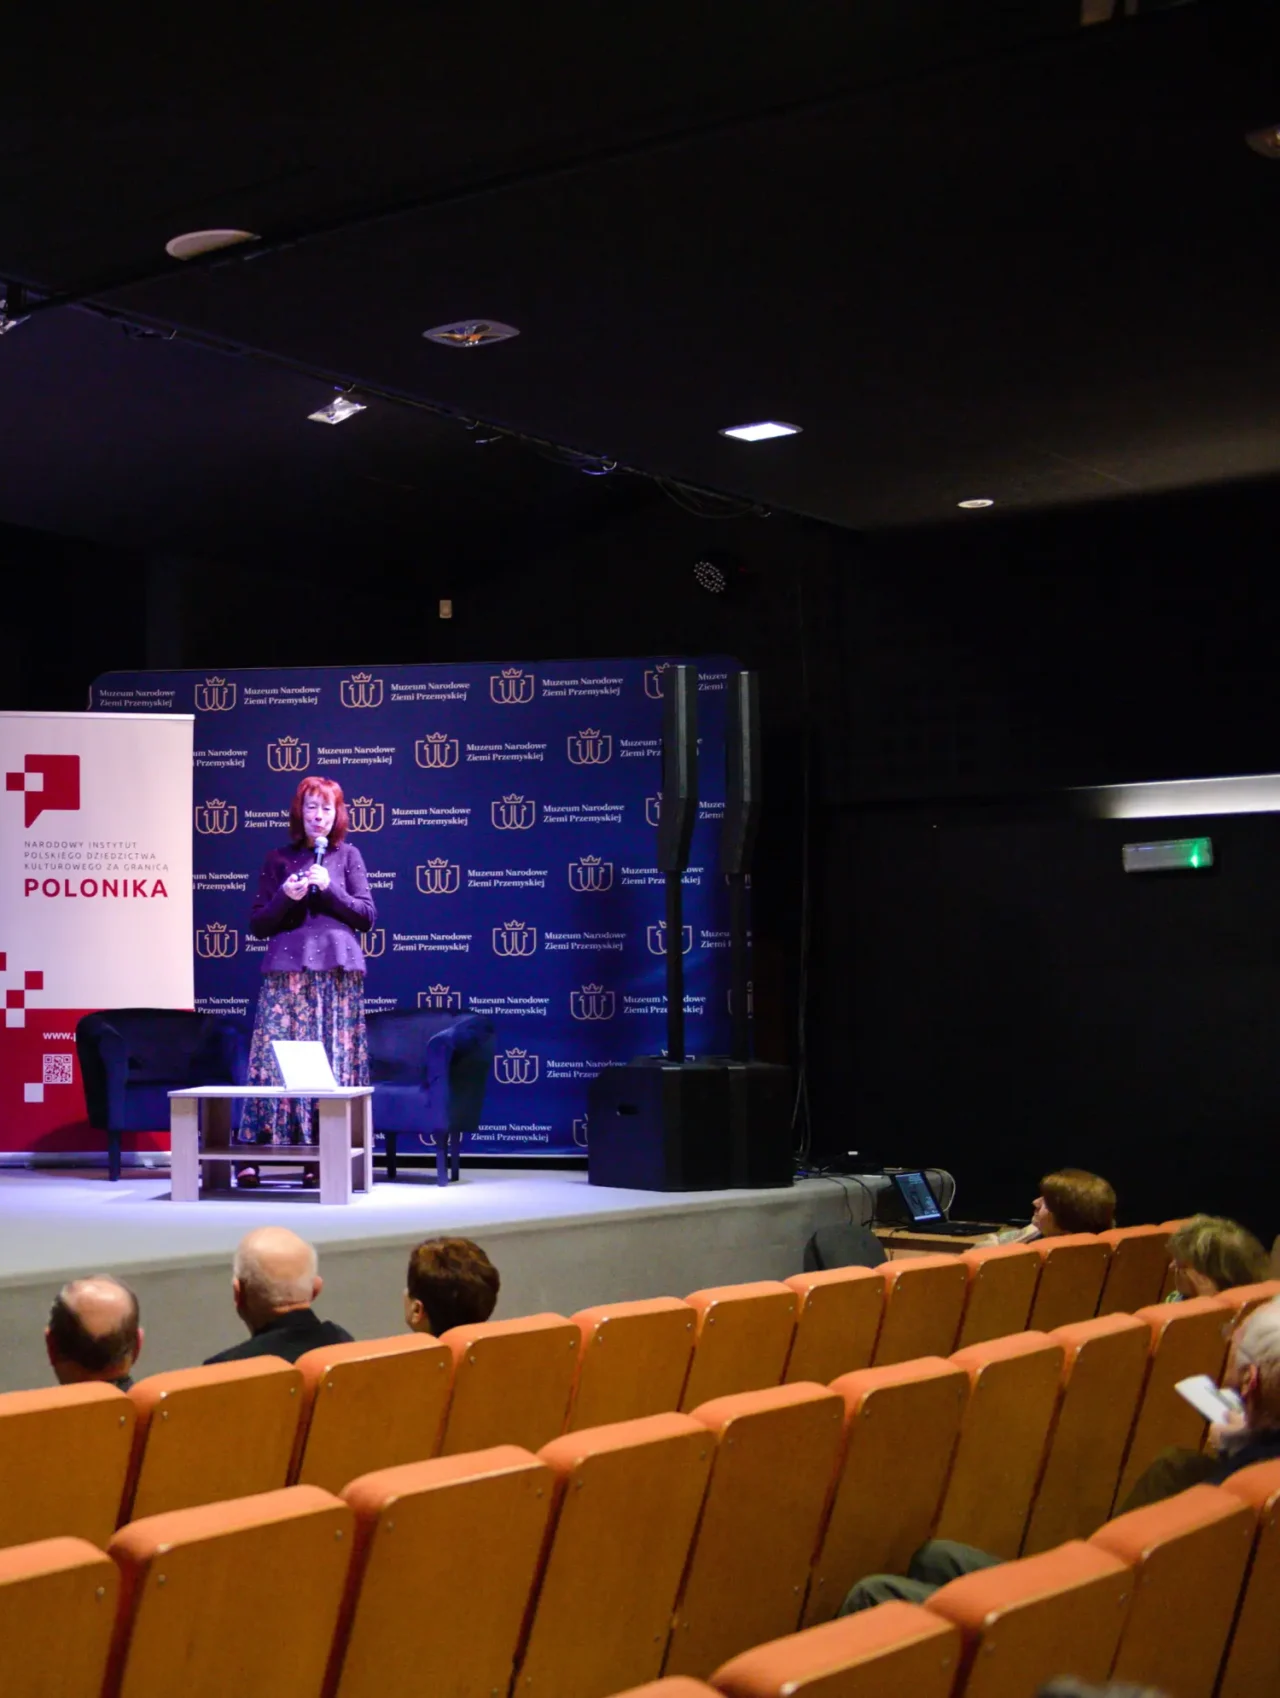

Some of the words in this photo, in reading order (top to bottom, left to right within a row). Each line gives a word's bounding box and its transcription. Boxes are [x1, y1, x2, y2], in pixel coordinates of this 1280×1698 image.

[698, 673, 728, 681] Muzeu
[390, 683, 426, 691] Muzeum
[428, 682, 471, 690] Narodowe
[542, 679, 579, 687] Muzeum
[581, 677, 623, 685] Narodowe
[244, 687, 278, 695] Muzeum
[280, 686, 322, 694] Narodowe
[698, 683, 723, 691] Ziemi
[99, 689, 134, 697] Muzeum
[135, 688, 176, 697] Narodowe
[391, 693, 415, 701] Ziemi
[416, 692, 467, 702] Przemyskiej
[542, 689, 567, 697] Ziemi
[568, 687, 621, 698] Przemyskiej
[100, 699, 122, 707] Ziemi
[124, 698, 173, 708] Przemyskiej
[243, 697, 267, 705] Ziemi
[268, 696, 318, 706] Przemyskiej
[466, 743, 502, 751] Muzeum
[504, 742, 547, 750] Narodowe
[620, 739, 658, 747] Muzeum
[208, 749, 248, 757] Narodowe
[317, 747, 352, 755] Muzeum
[354, 745, 396, 754] Narodowe
[620, 749, 645, 757] Ziemi
[317, 757, 341, 765] Ziemi
[342, 756, 393, 766] Przemyskiej
[466, 753, 491, 762] Ziemi
[492, 752, 544, 762] Przemyskiej
[196, 758, 246, 768] Przemyskiej
[543, 805, 580, 813] Muzeum
[582, 803, 625, 812] Narodowe
[699, 801, 725, 809] Muze
[245, 810, 280, 818] Muzeum
[392, 808, 427, 816] Muzeum
[429, 806, 471, 815] Narodowe
[392, 818, 416, 826] Ziemi
[417, 817, 468, 827] Przemyskiej
[543, 815, 568, 823] Ziemi
[569, 813, 622, 824] Przemyskiej
[245, 820, 268, 828] Ziemi
[24, 841, 84, 849] NARODOWY
[88, 841, 137, 849] INSTYTUT
[24, 863, 102, 871] KULTUROWEGO
[106, 863, 119, 871] ZA
[123, 864, 169, 872] GRANICĄ
[621, 867, 659, 875] Muzeum
[208, 872, 249, 880] Narodowe
[467, 869, 504, 877] Muzeum
[505, 868, 548, 876] Narodowe
[467, 879, 492, 888] Ziemi
[493, 878, 545, 888] Przemyskiej
[621, 877, 646, 885] Ziemi
[24, 878, 168, 898] POLONIKA
[197, 882, 246, 892] Przemyskiej
[392, 933, 429, 941] Muzeum
[430, 932, 473, 940] Narodowe
[544, 932, 581, 940] Muzeum
[583, 931, 626, 939] Narodowe
[700, 930, 730, 938] Muzeu
[392, 944, 417, 952] Ziemi
[418, 942, 470, 952] Przemyskiej
[544, 942, 569, 950] Ziemi
[571, 941, 623, 952] Przemyskiej
[701, 940, 726, 949] Ziemi
[363, 996, 398, 1004] arodowe
[469, 996, 505, 1004] Muzeum
[507, 995, 550, 1004] Narodowe
[623, 996, 661, 1004] Muzeum
[197, 1006, 247, 1016] Przemyskiej
[495, 1006, 547, 1016] Przemyskiej
[624, 1006, 649, 1014] Ziemi
[546, 1060, 584, 1068] Muzeum
[546, 1070, 572, 1078] Ziemi
[509, 1123, 552, 1131] Narodowe
[471, 1133, 495, 1141] Ziemi
[497, 1133, 549, 1144] Przemyskiej
